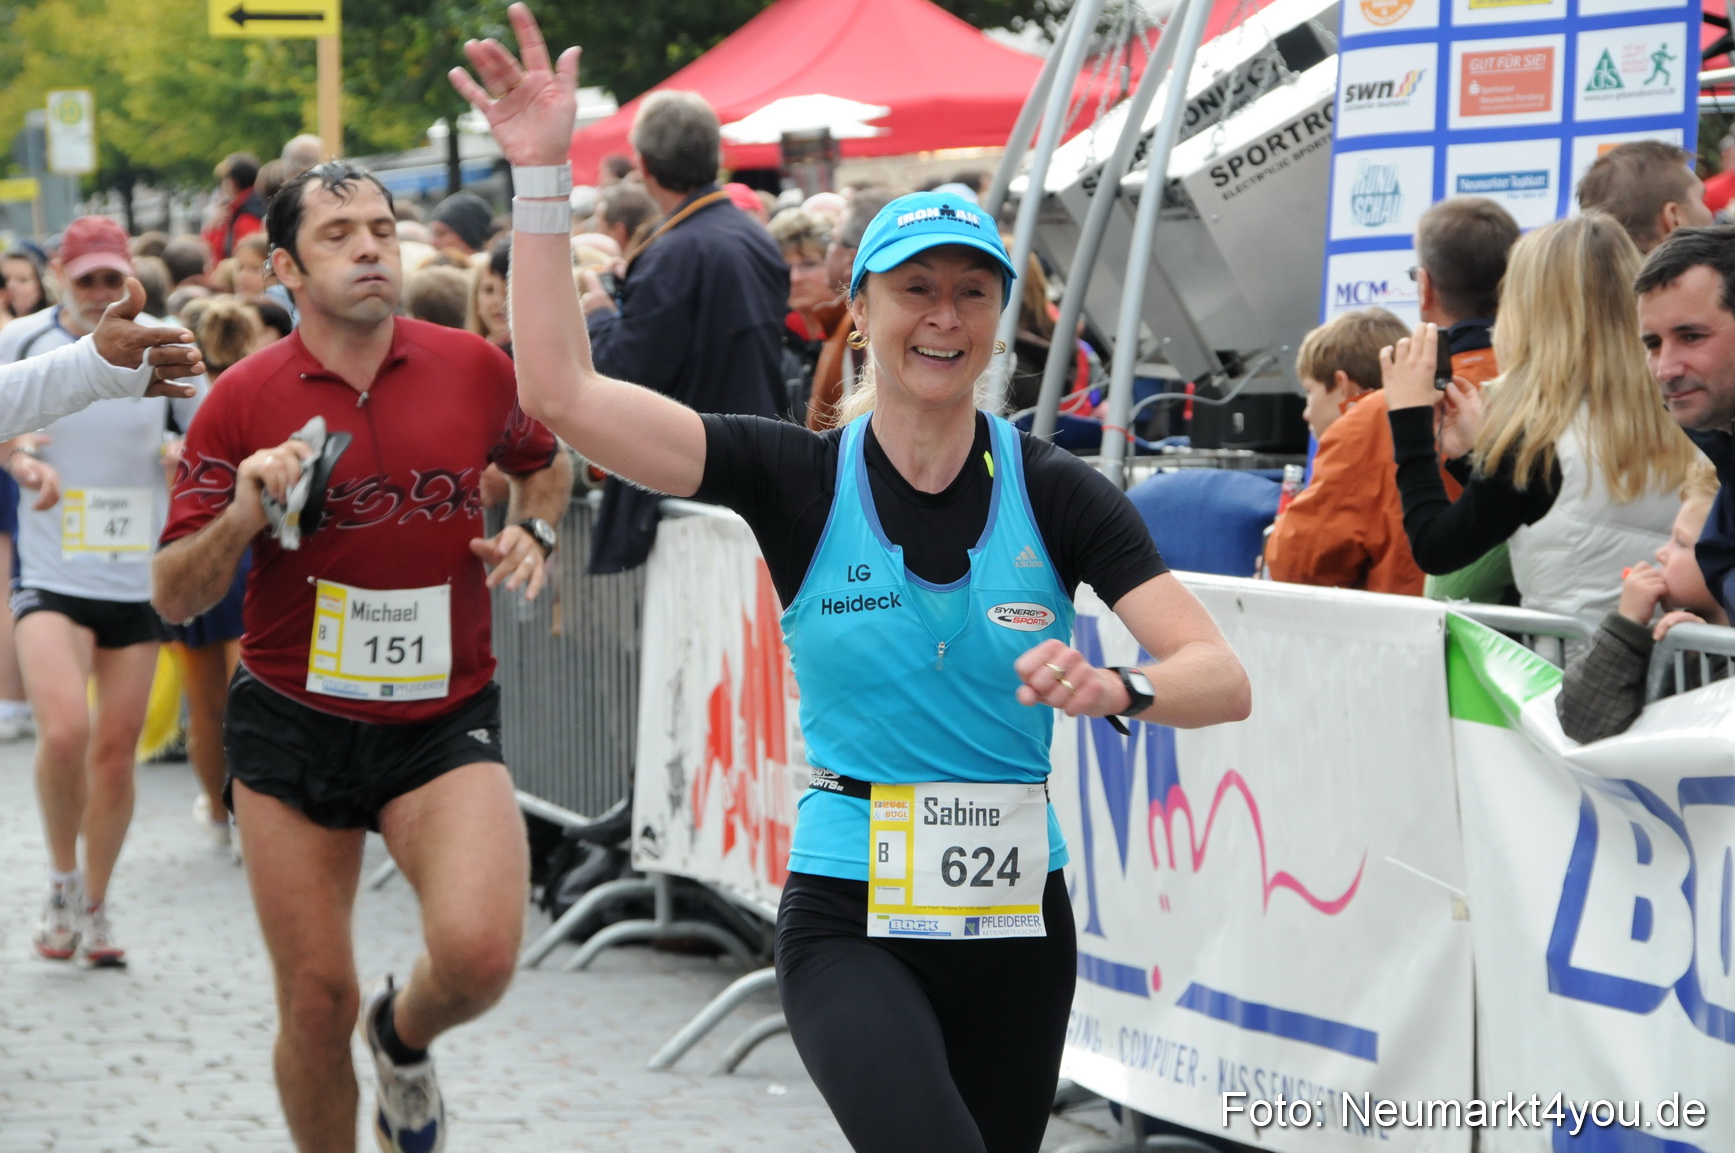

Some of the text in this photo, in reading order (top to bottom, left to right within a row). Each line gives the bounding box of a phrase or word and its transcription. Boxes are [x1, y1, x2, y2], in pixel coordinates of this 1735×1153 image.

[1470, 53, 1547, 71] GUT FÜR SIE!
[1345, 80, 1395, 103] swn
[897, 204, 980, 228] IRONMAN
[103, 516, 130, 538] 47
[848, 564, 872, 582] LG
[351, 600, 418, 621] Michael
[821, 592, 902, 615] Heideck
[994, 607, 1040, 616] SYNERGY
[364, 635, 425, 664] 151
[924, 797, 1000, 827] Sabine
[878, 842, 889, 863] B
[941, 846, 1021, 888] 624
[890, 915, 1041, 931] BOCK PFLEIDERER
